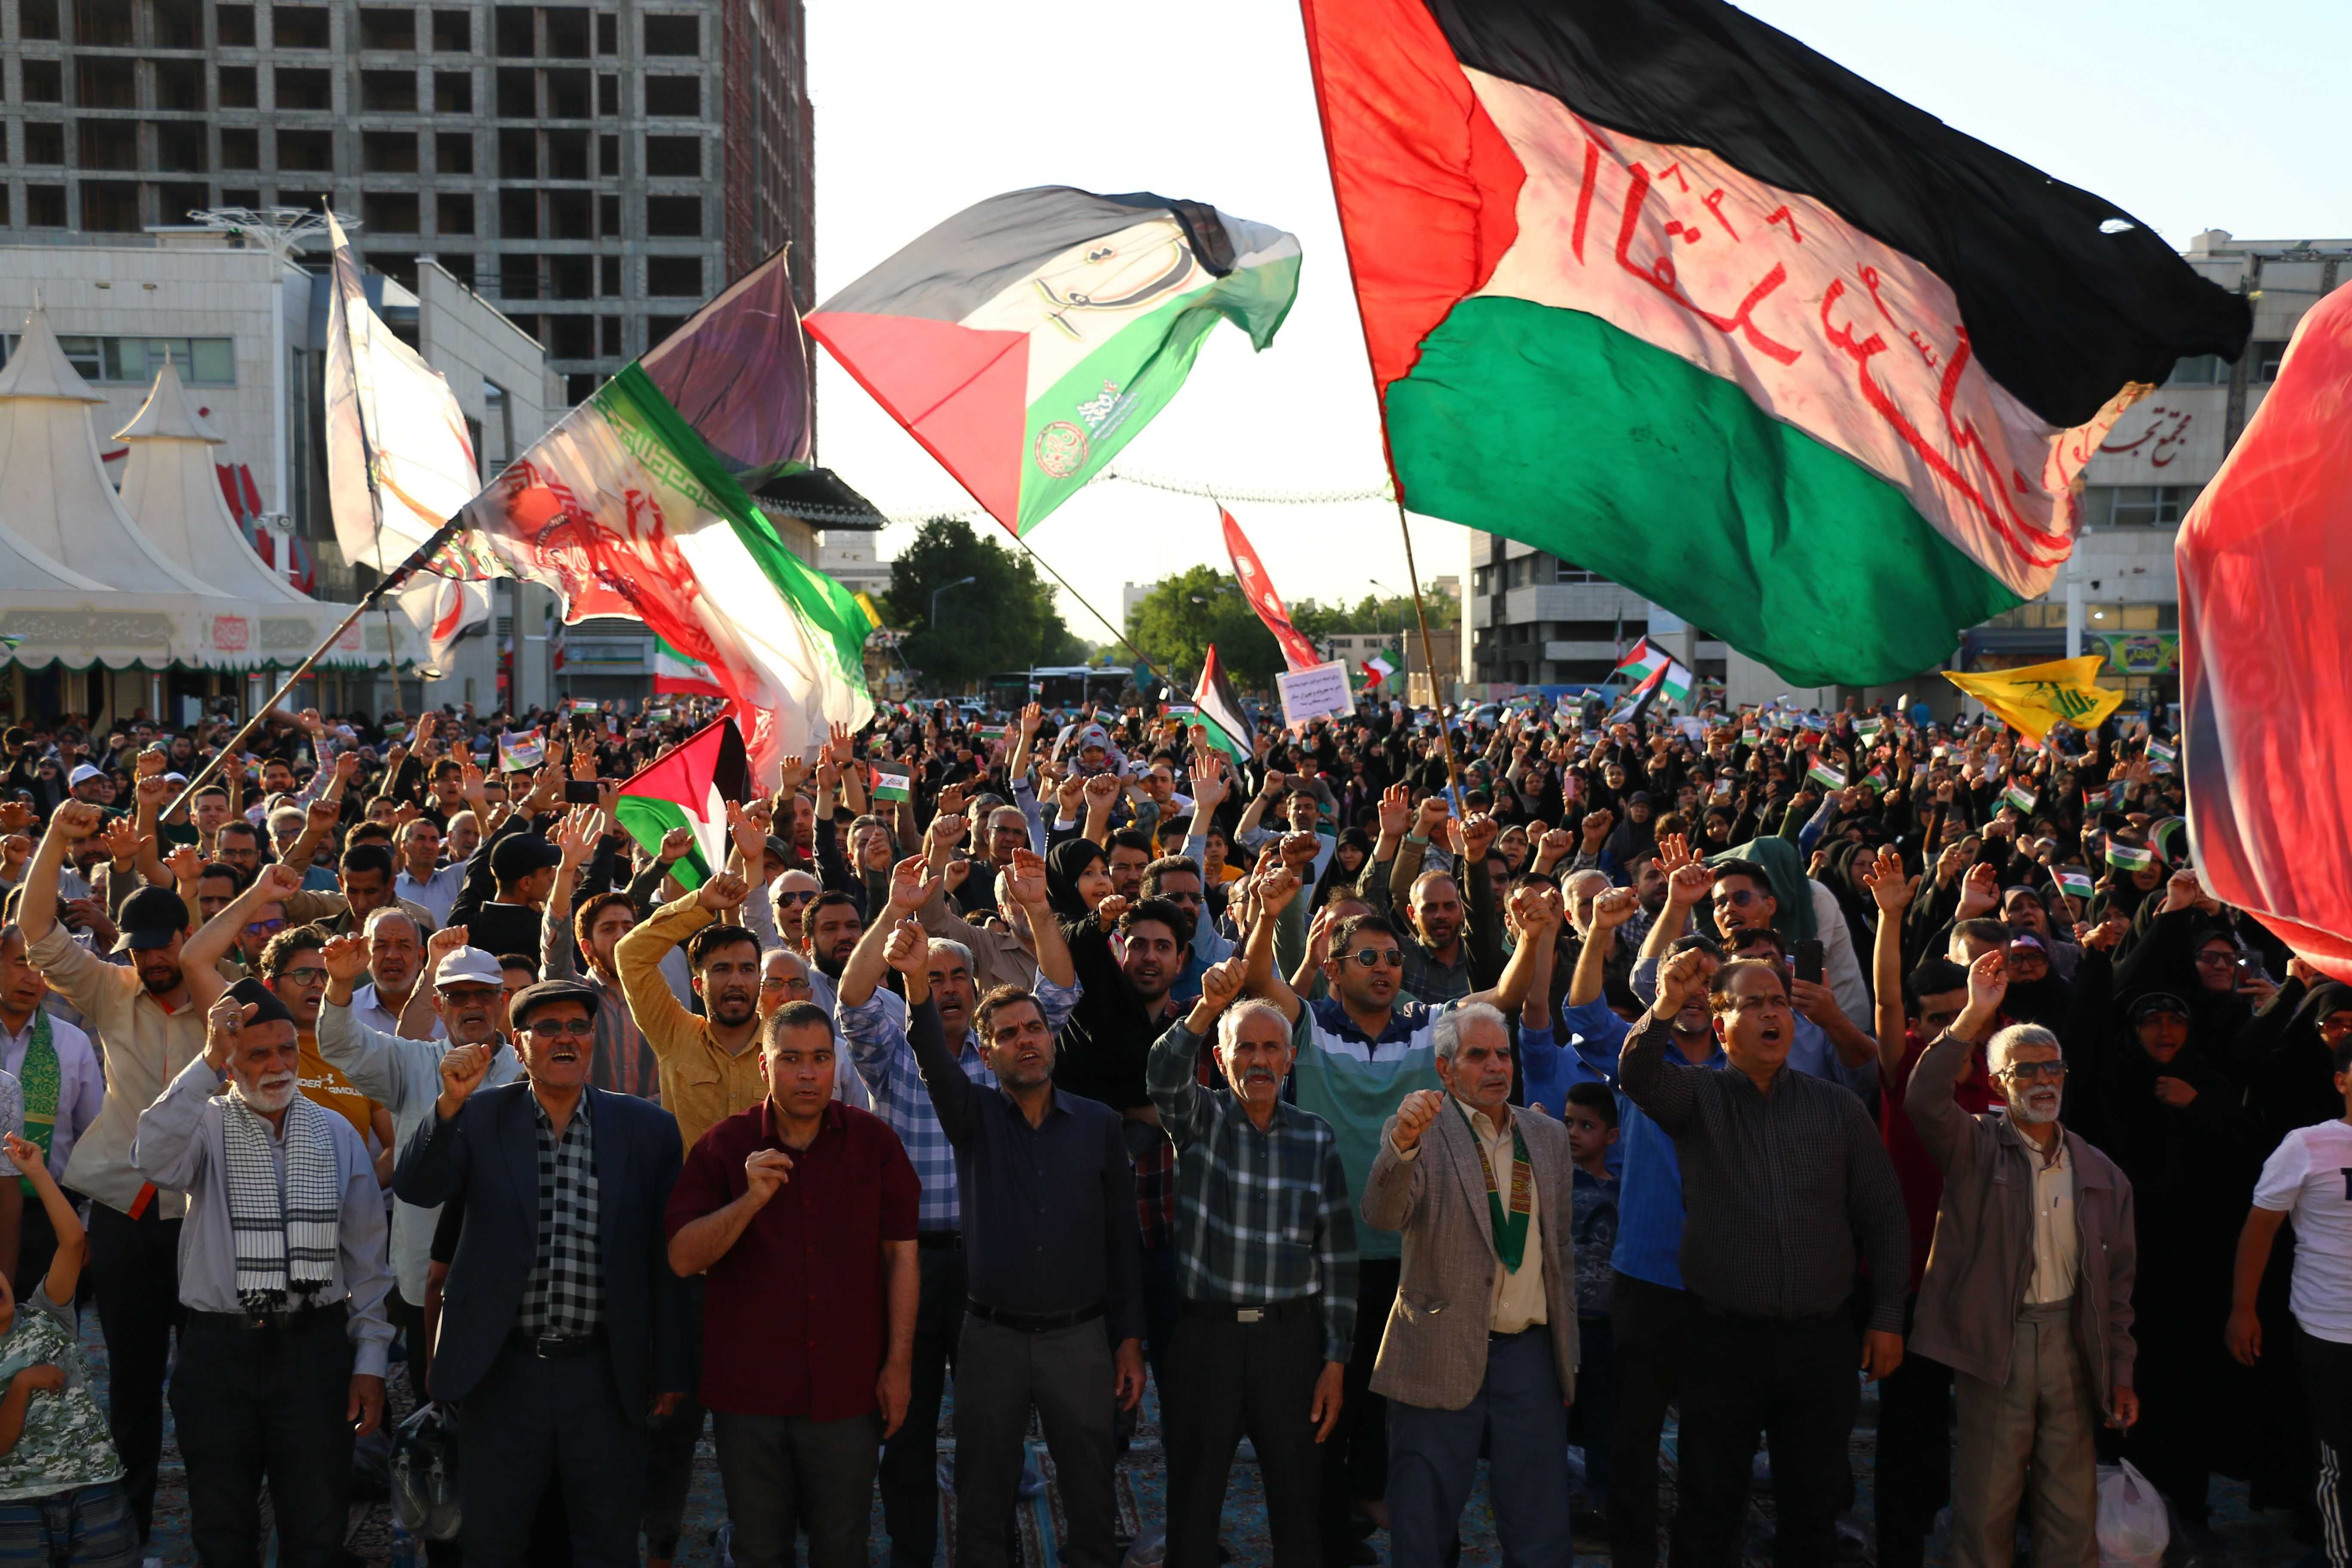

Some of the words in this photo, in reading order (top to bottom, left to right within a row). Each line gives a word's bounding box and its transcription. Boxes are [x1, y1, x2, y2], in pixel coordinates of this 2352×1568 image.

[2152, 412, 2192, 467] مجتمع
[297, 1078, 322, 1088] DER
[324, 1087, 363, 1096] RMOU
